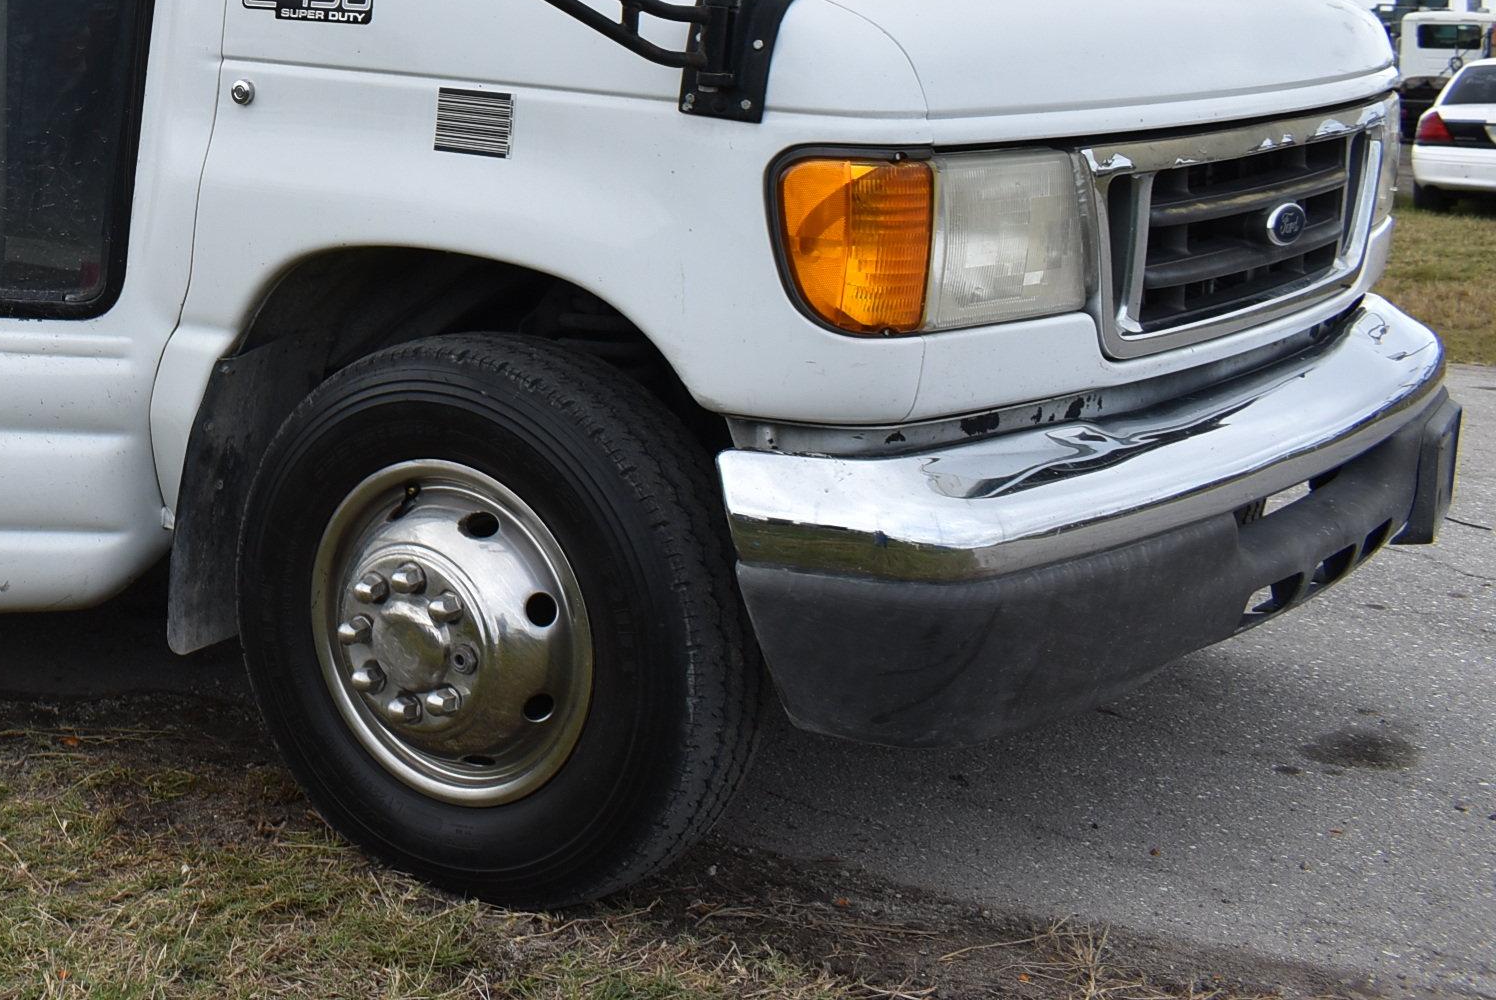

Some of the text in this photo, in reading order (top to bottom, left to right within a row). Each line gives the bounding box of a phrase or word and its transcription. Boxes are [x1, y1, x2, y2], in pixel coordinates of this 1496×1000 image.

[280, 7, 366, 22] SUPER DUTY
[1280, 212, 1300, 235] Ford
